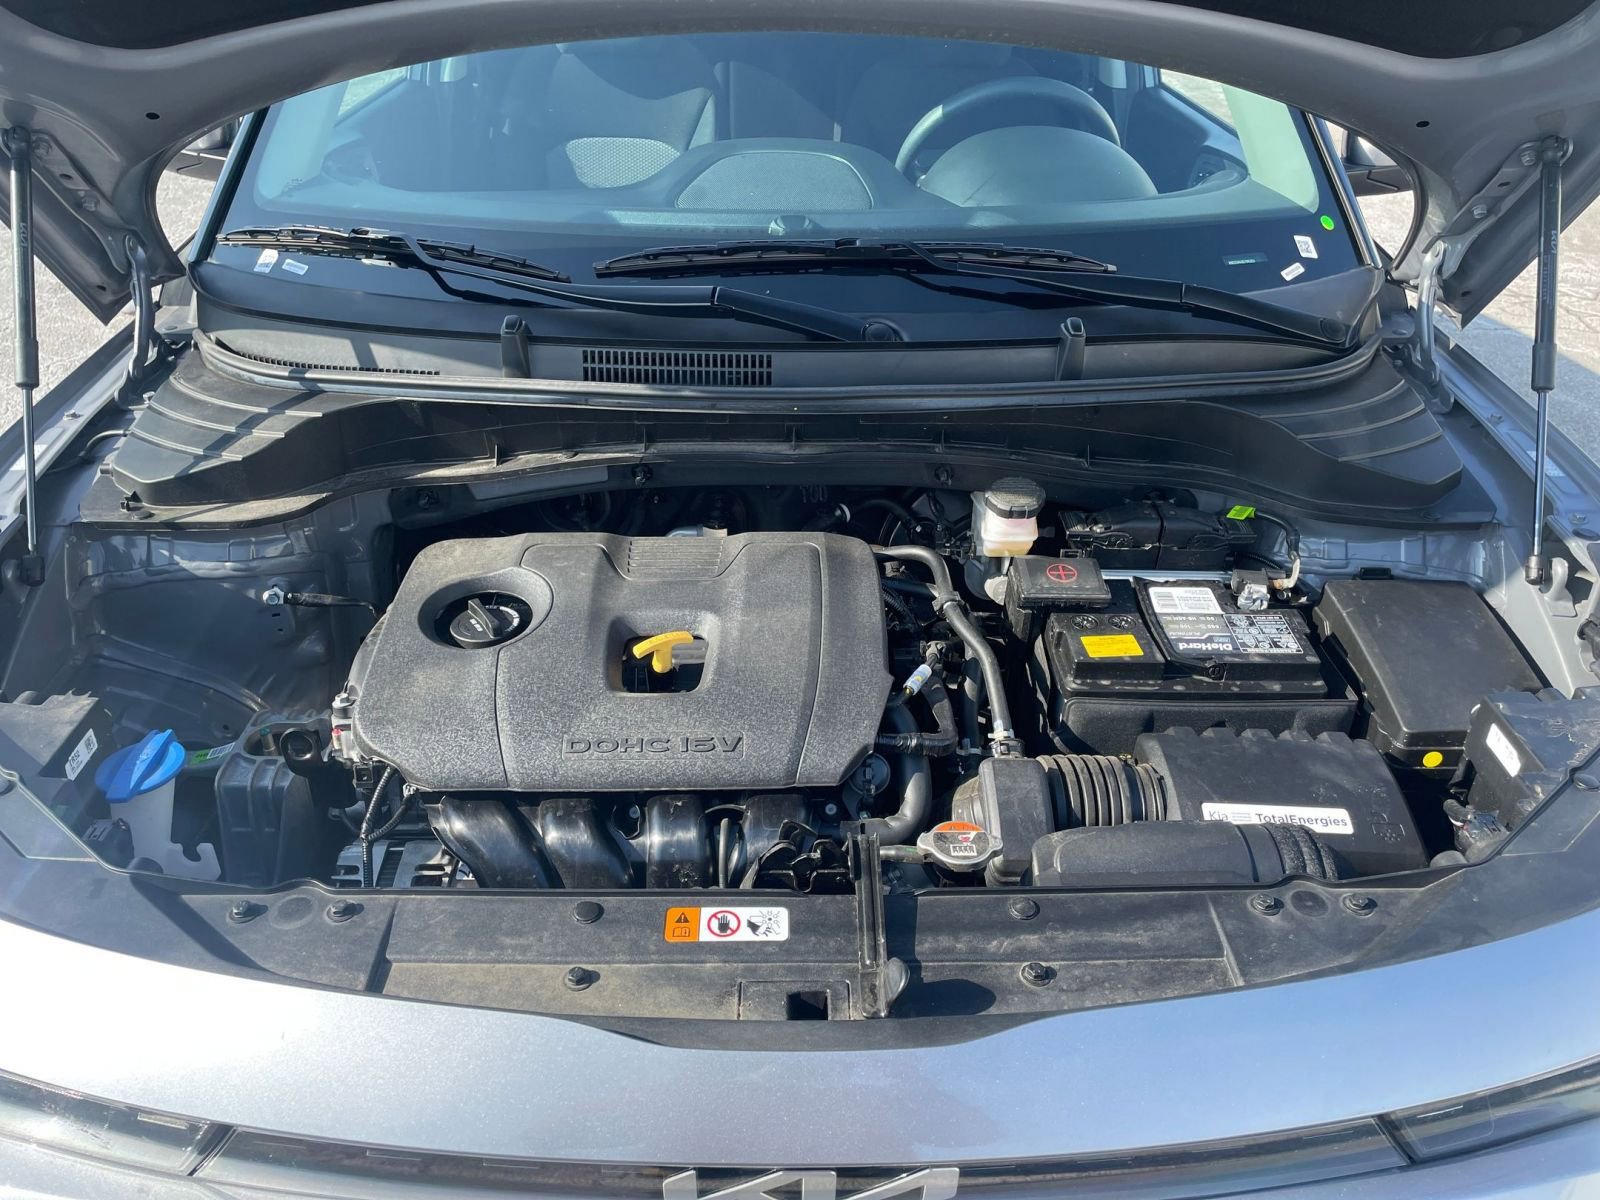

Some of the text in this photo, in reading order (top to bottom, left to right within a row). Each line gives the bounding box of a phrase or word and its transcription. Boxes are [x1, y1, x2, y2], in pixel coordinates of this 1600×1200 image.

[1179, 642, 1233, 651] DieHard
[565, 736, 743, 753] DOHC 16V
[1208, 810, 1229, 821] Kia
[1255, 813, 1348, 827] TotalEnergies
